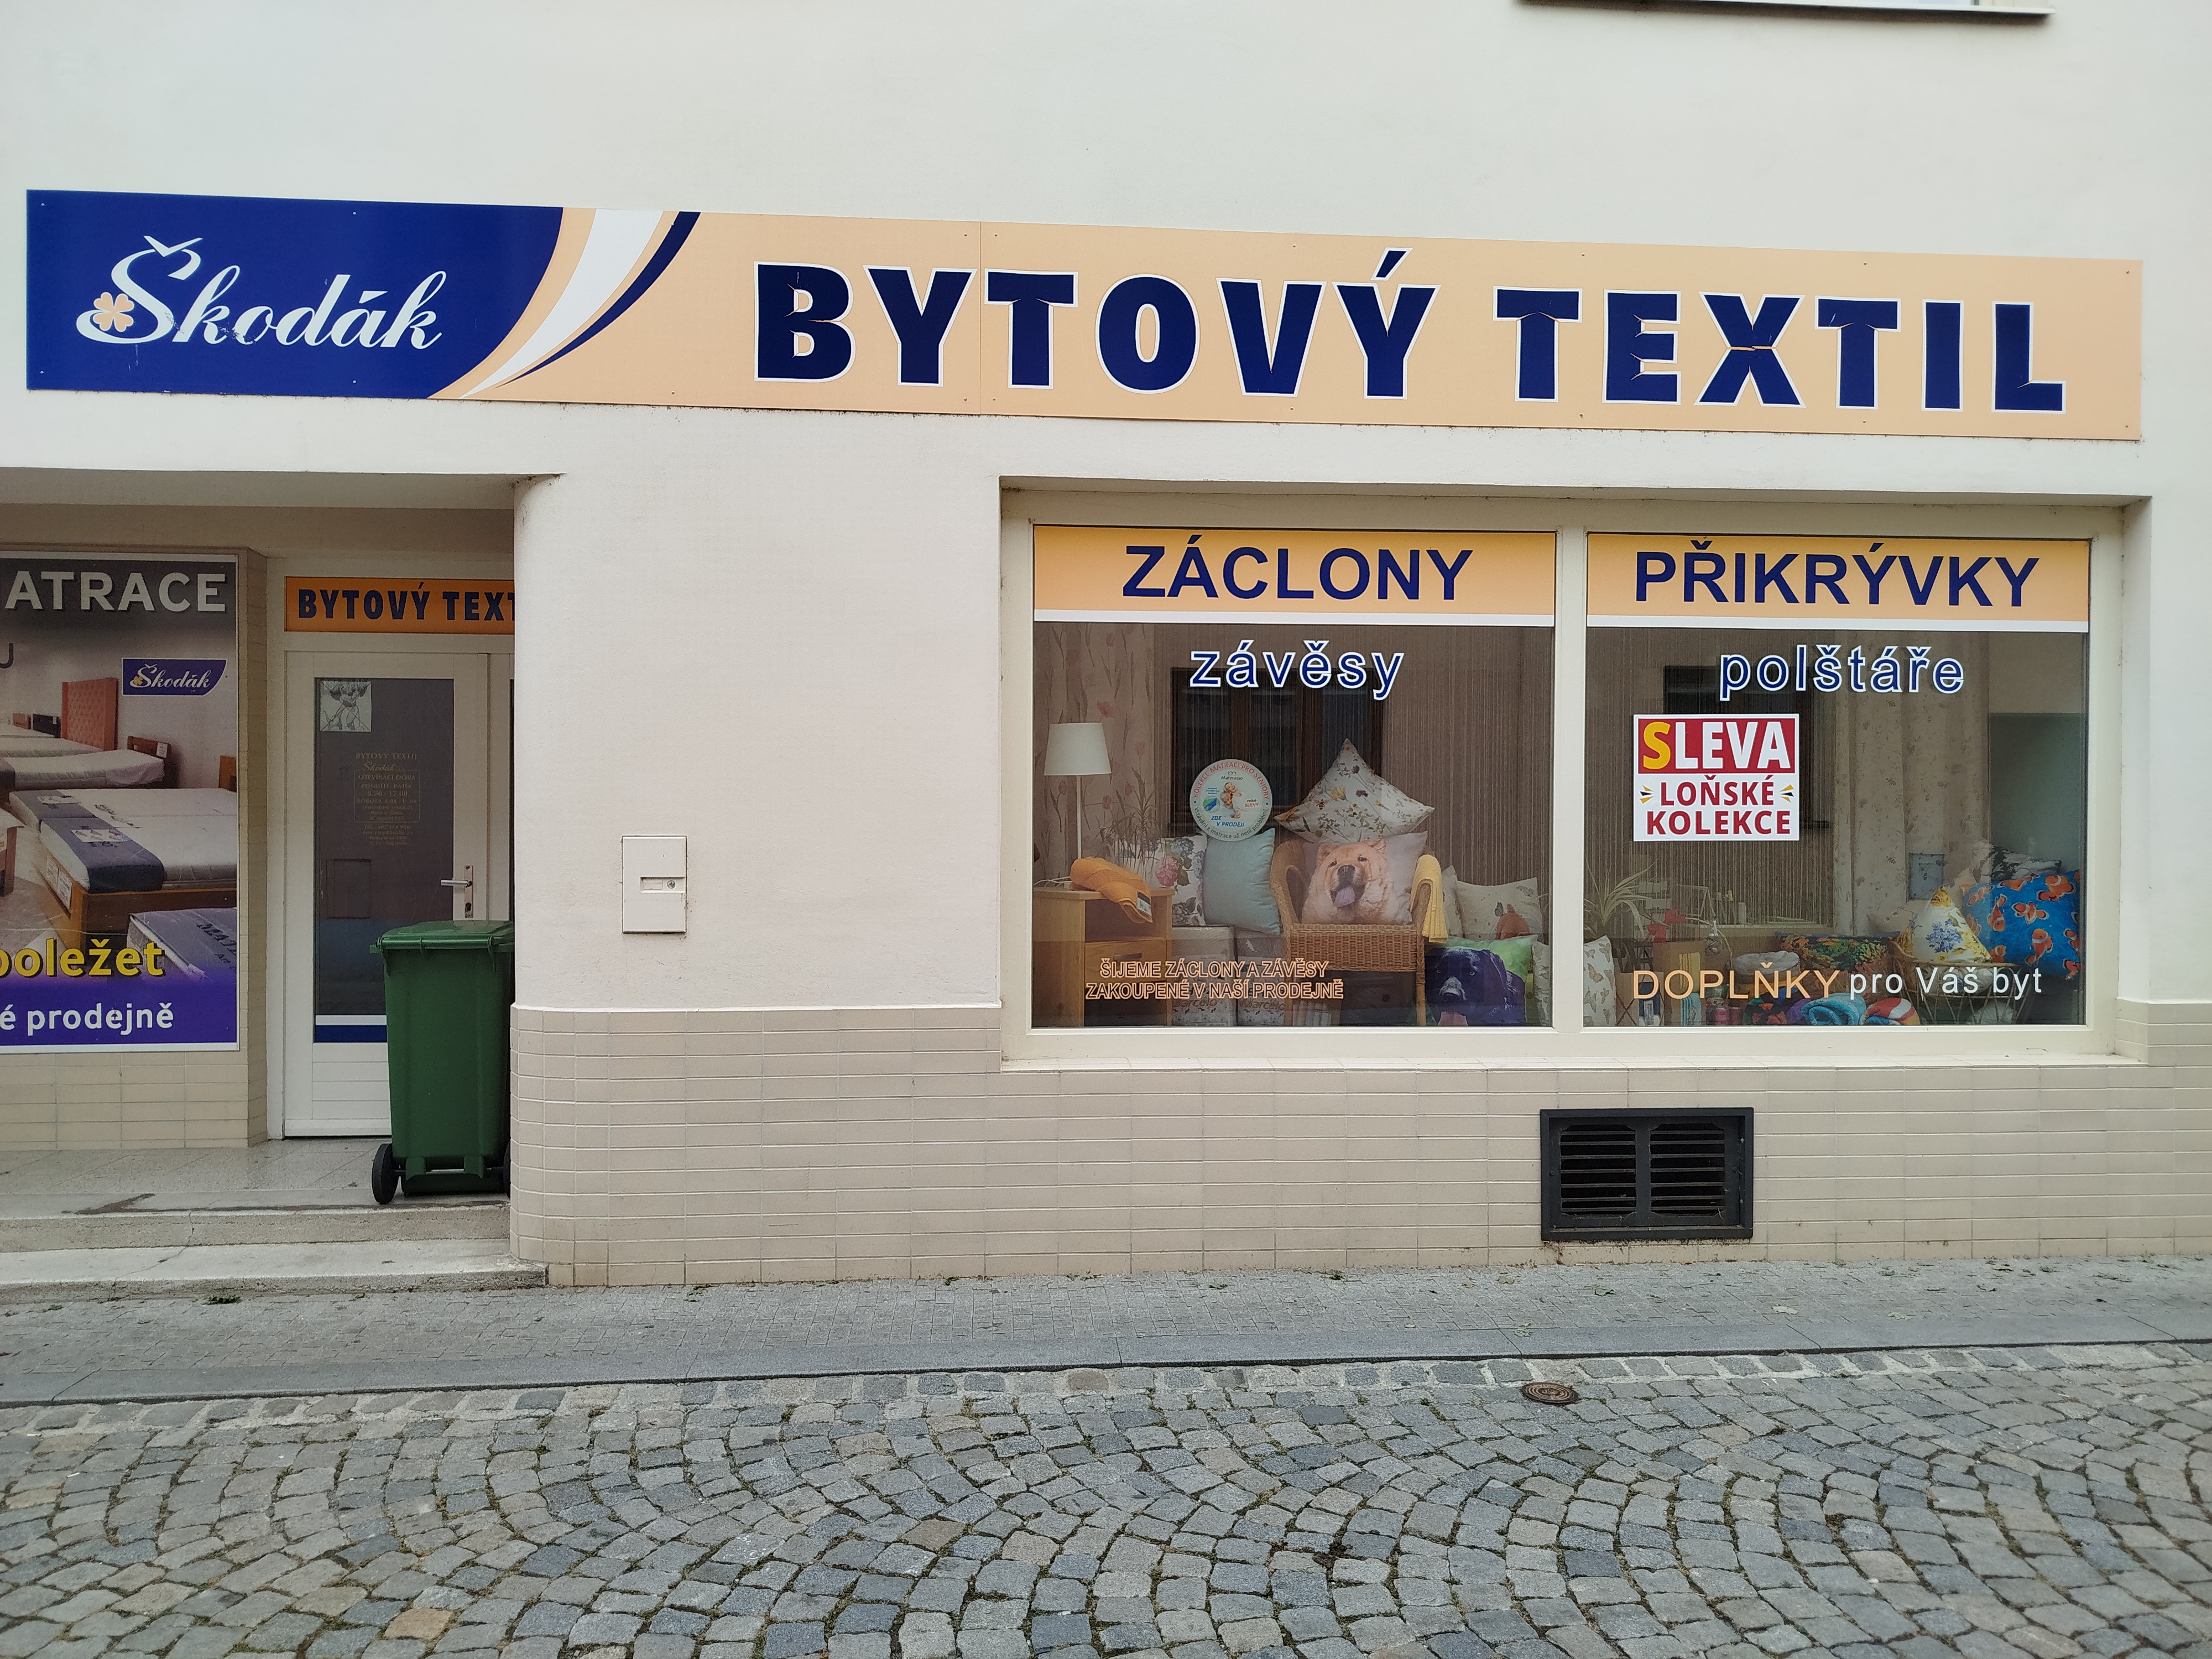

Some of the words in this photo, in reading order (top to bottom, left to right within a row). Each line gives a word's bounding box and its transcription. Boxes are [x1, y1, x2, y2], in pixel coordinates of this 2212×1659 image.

[76, 236, 446, 349] Škodák
[754, 248, 1441, 399] BYTOVÝ
[1493, 286, 2066, 414] TEXTIL
[1123, 535, 1474, 600] ZÁCLONY
[1635, 540, 2040, 607] PŘIKRÝVKY
[299, 582, 430, 619] BYTOVÝ
[129, 664, 211, 688] Škodák
[1190, 639, 1404, 700] závěsy
[1719, 644, 1964, 701] polštáře
[1642, 721, 1791, 770] SLEVA
[1194, 771, 1209, 797] KOLEKCE
[1241, 764, 1254, 774] PRO
[1254, 773, 1269, 799] SENIORY
[1660, 775, 1775, 807] LOŇSKÉ
[1194, 807, 1208, 828] Vstávání
[1211, 830, 1232, 838] matrace
[1241, 828, 1252, 837] není
[1646, 810, 1791, 835] KOLEKCE
[1099, 957, 1161, 978] ŠIJEME
[1165, 957, 1246, 978] ZÁCLONY
[1246, 961, 1260, 978] A
[1261, 957, 1329, 978] ZÁVĚSY
[1633, 962, 1839, 1000] DOPLŇKY
[1850, 972, 1903, 1000] pro
[1916, 966, 1979, 994] Váš
[1992, 967, 2043, 1001] byt
[1085, 979, 1190, 999] ZAKOUPENÉ
[1192, 982, 1206, 999] V
[1209, 979, 1250, 999] NAŠÍ
[1253, 979, 1344, 1000] PRODEJNĚ
[27, 1002, 174, 1036] prodejně
